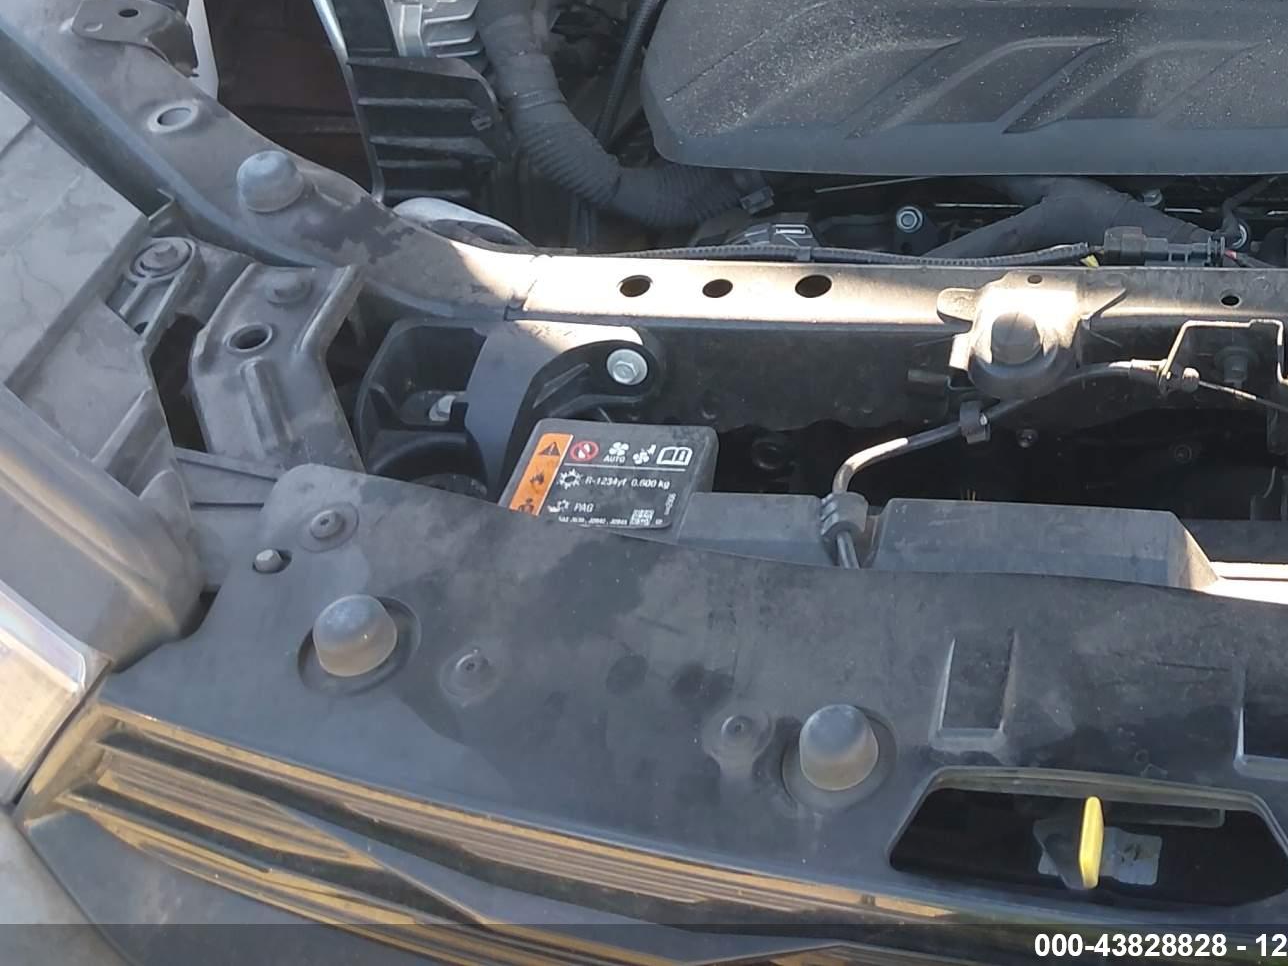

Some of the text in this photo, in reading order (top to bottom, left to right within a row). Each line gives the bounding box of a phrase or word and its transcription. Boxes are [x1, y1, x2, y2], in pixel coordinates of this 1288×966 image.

[603, 454, 626, 464] AUTO
[584, 475, 627, 488] R-1234yf
[657, 479, 671, 490] kg
